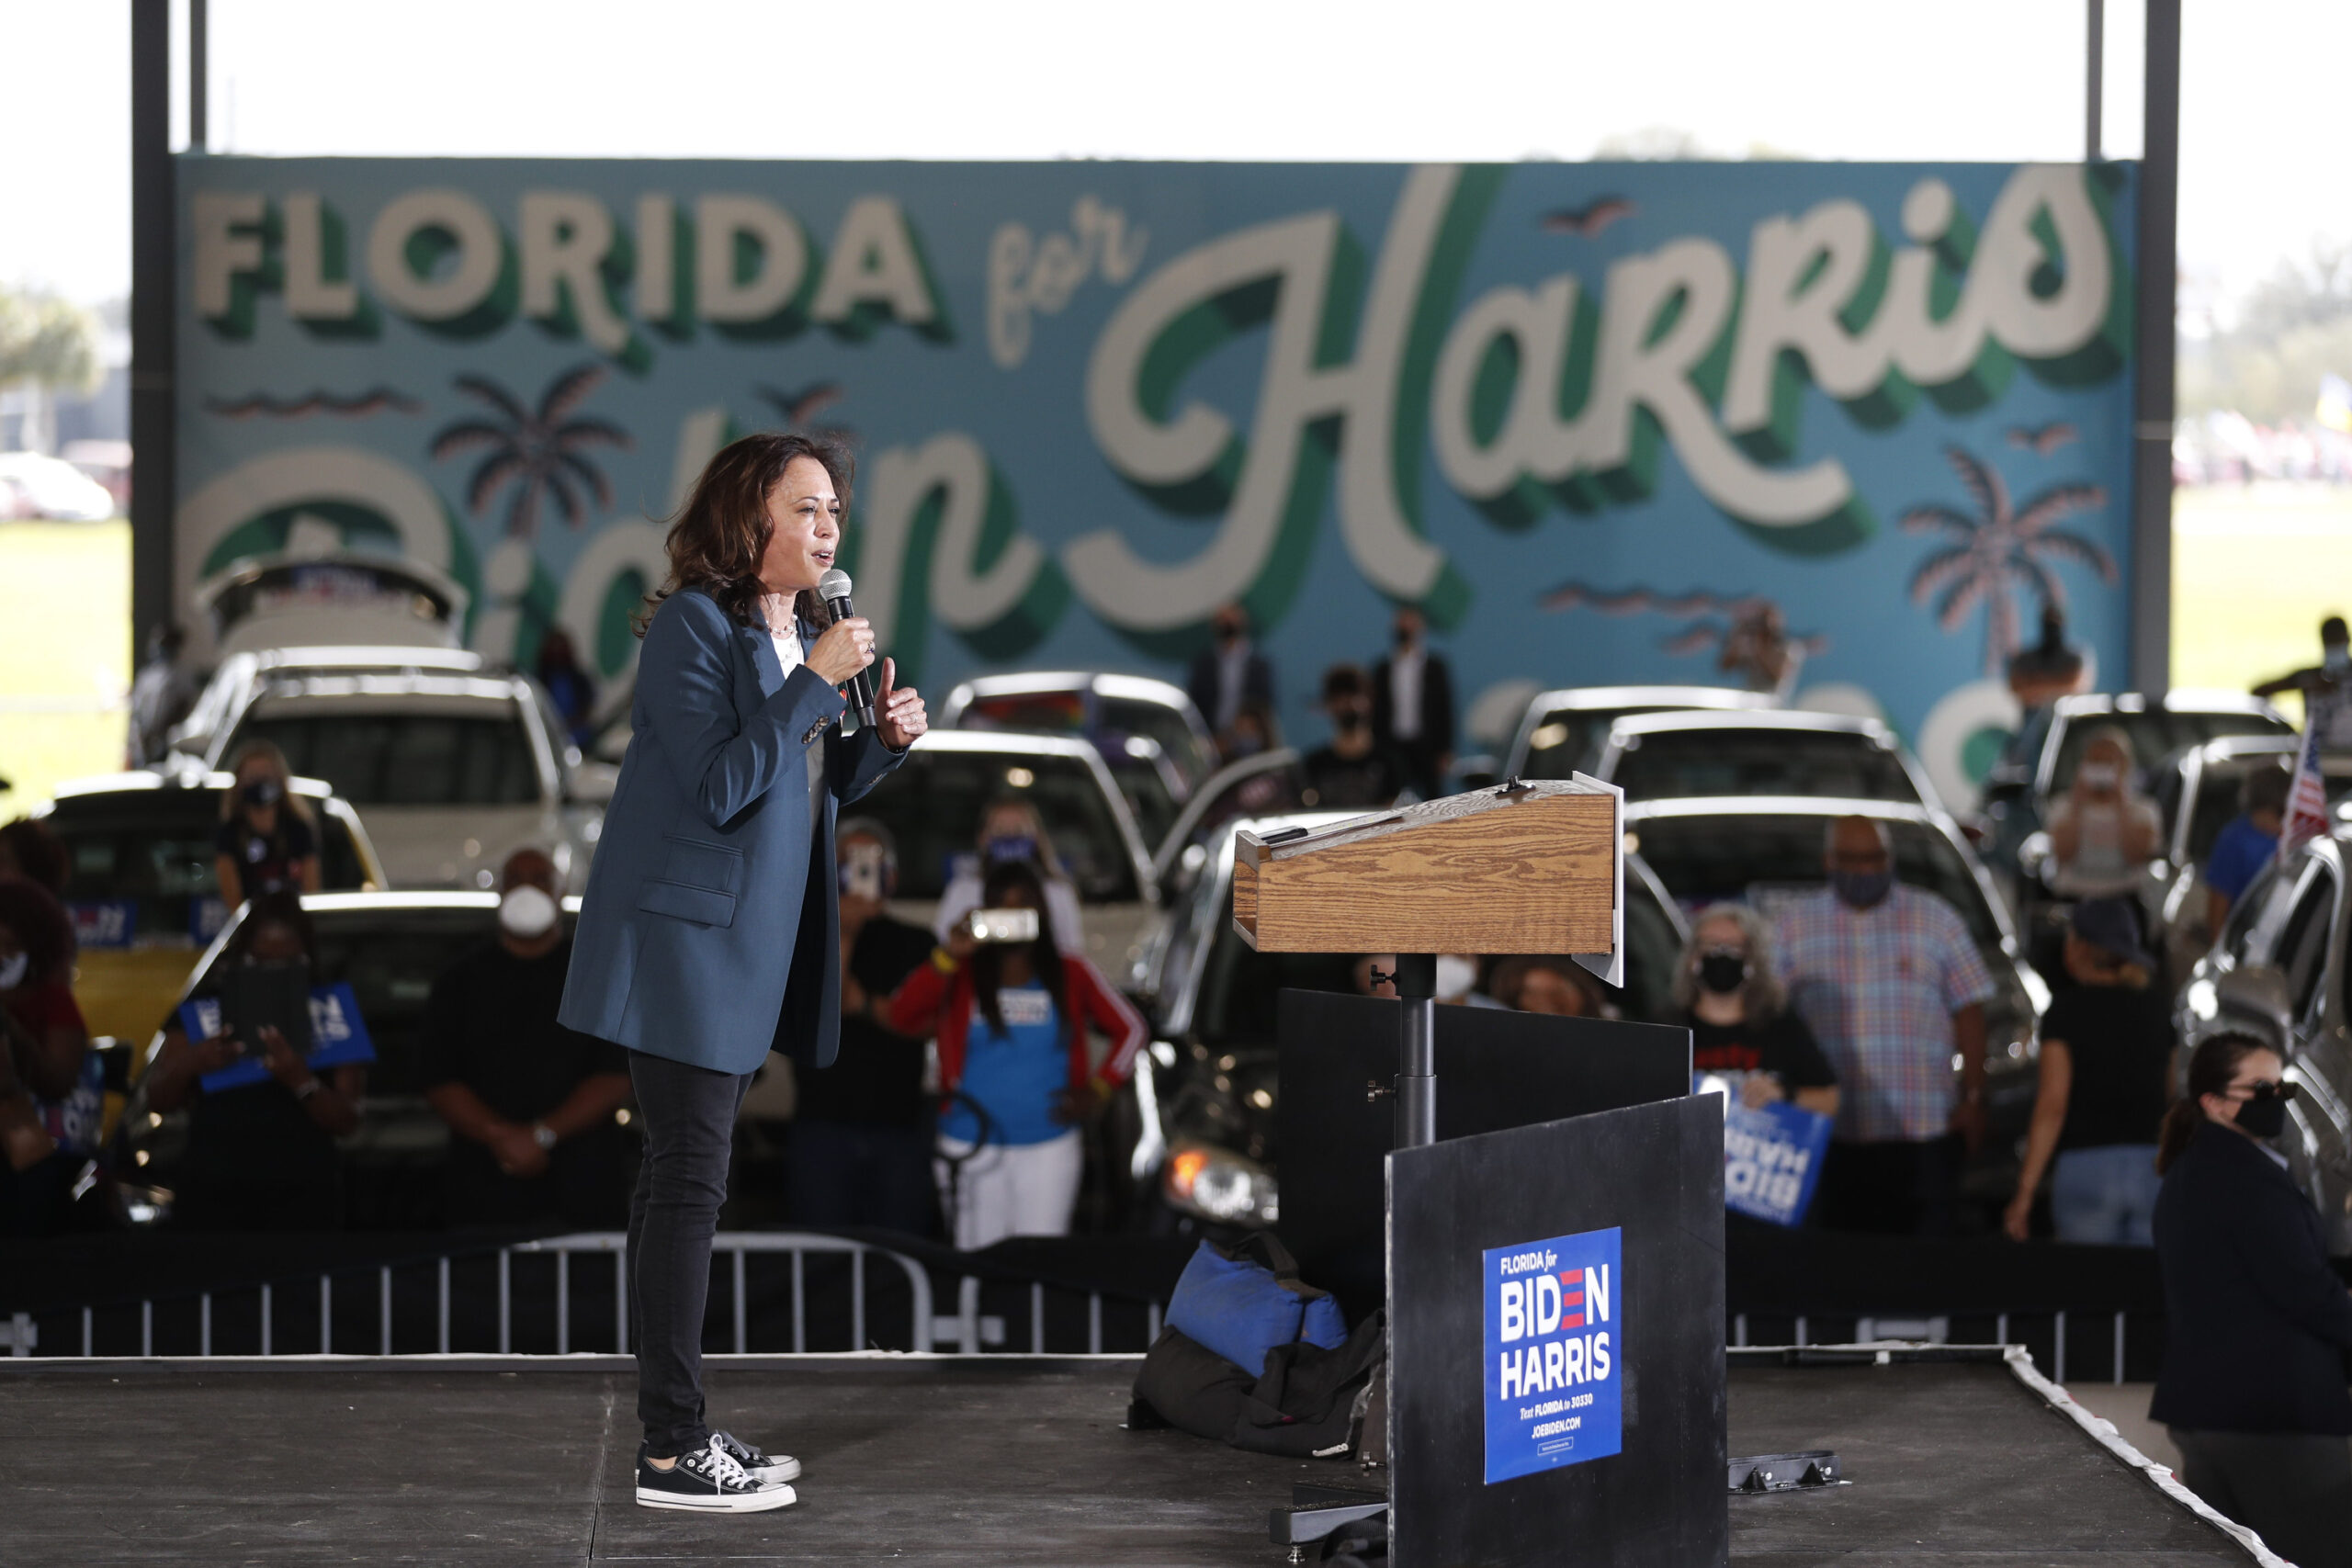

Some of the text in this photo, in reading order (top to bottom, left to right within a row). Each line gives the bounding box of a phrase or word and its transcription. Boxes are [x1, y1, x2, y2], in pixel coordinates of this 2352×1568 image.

[192, 189, 1150, 368] FLORIDA for
[175, 409, 1046, 716] idn
[1724, 1159, 1802, 1211] BID
[1500, 1248, 1558, 1275] FLORIDA for
[1500, 1263, 1610, 1343] BIDEN
[1500, 1331, 1611, 1401] HARRIS
[1520, 1393, 1594, 1421] Text FLORIDA to 30330
[1532, 1416, 1581, 1439] JOEBIDEN.COM
